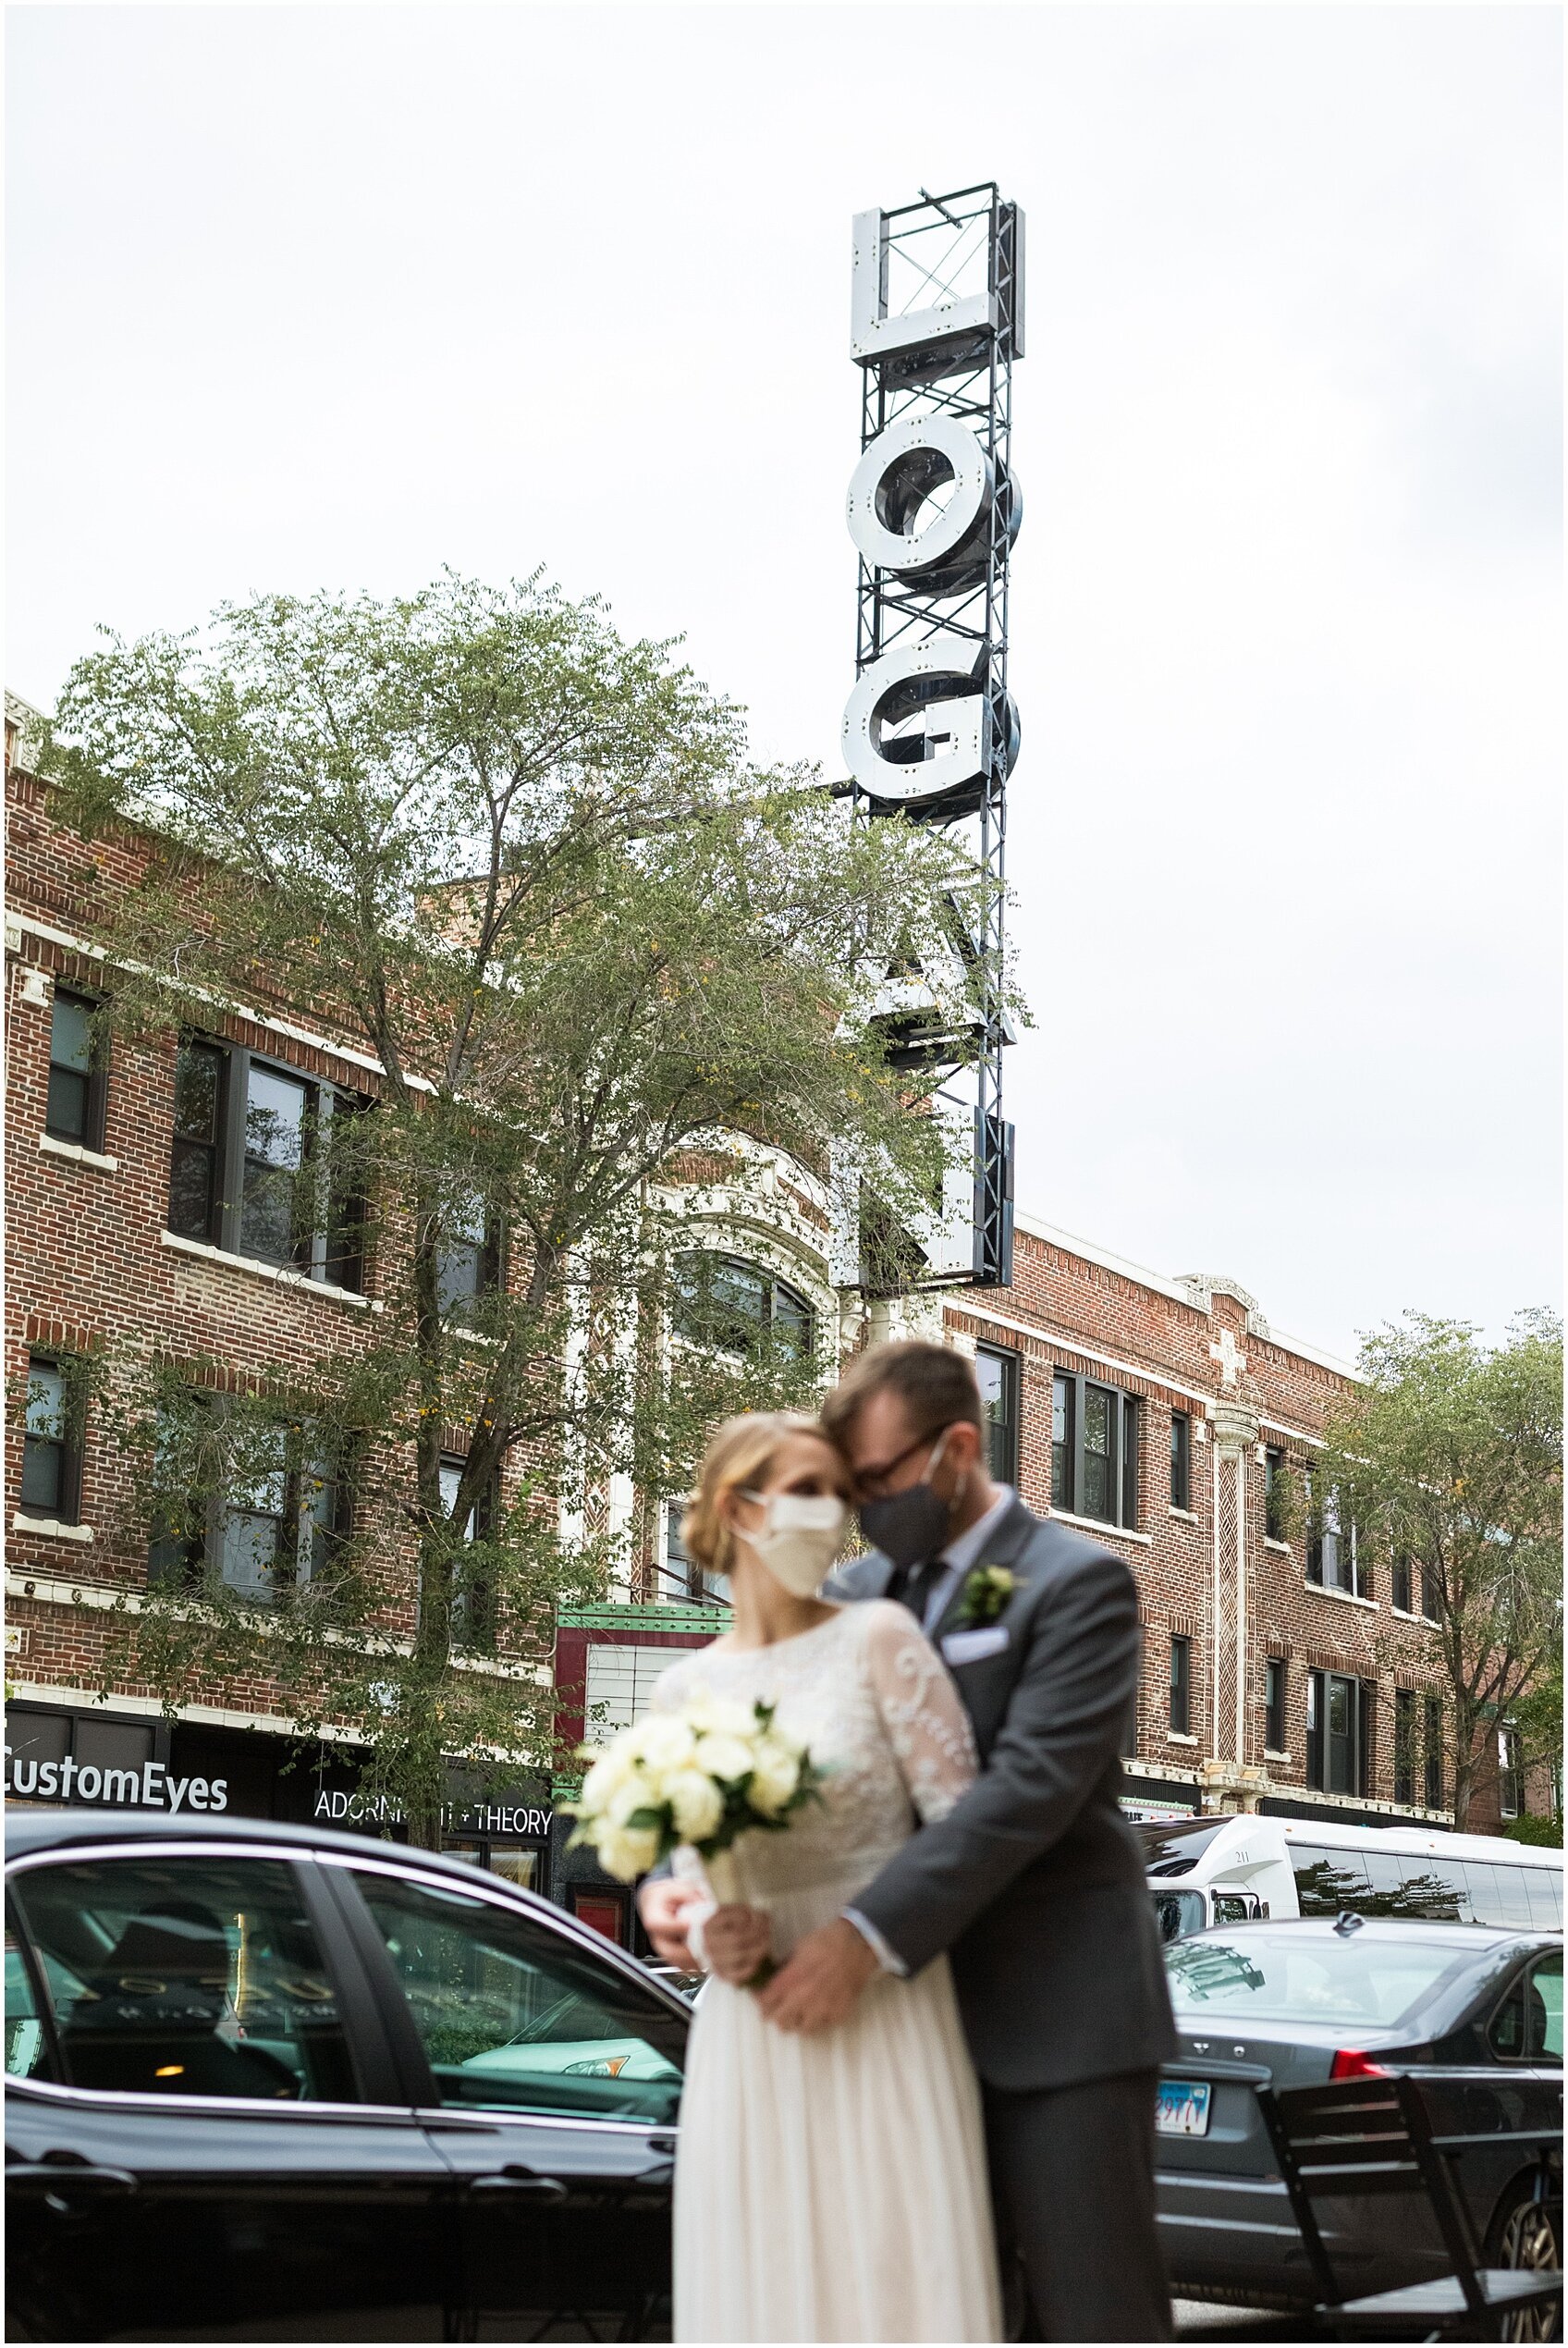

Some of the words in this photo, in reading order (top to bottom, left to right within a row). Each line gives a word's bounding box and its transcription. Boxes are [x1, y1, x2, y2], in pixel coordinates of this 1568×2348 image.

[831, 205, 1002, 1287] LOGAN
[314, 1791, 453, 1825] ADORNT
[473, 1803, 553, 1835] THEORY
[1235, 1850, 1249, 1863] 211
